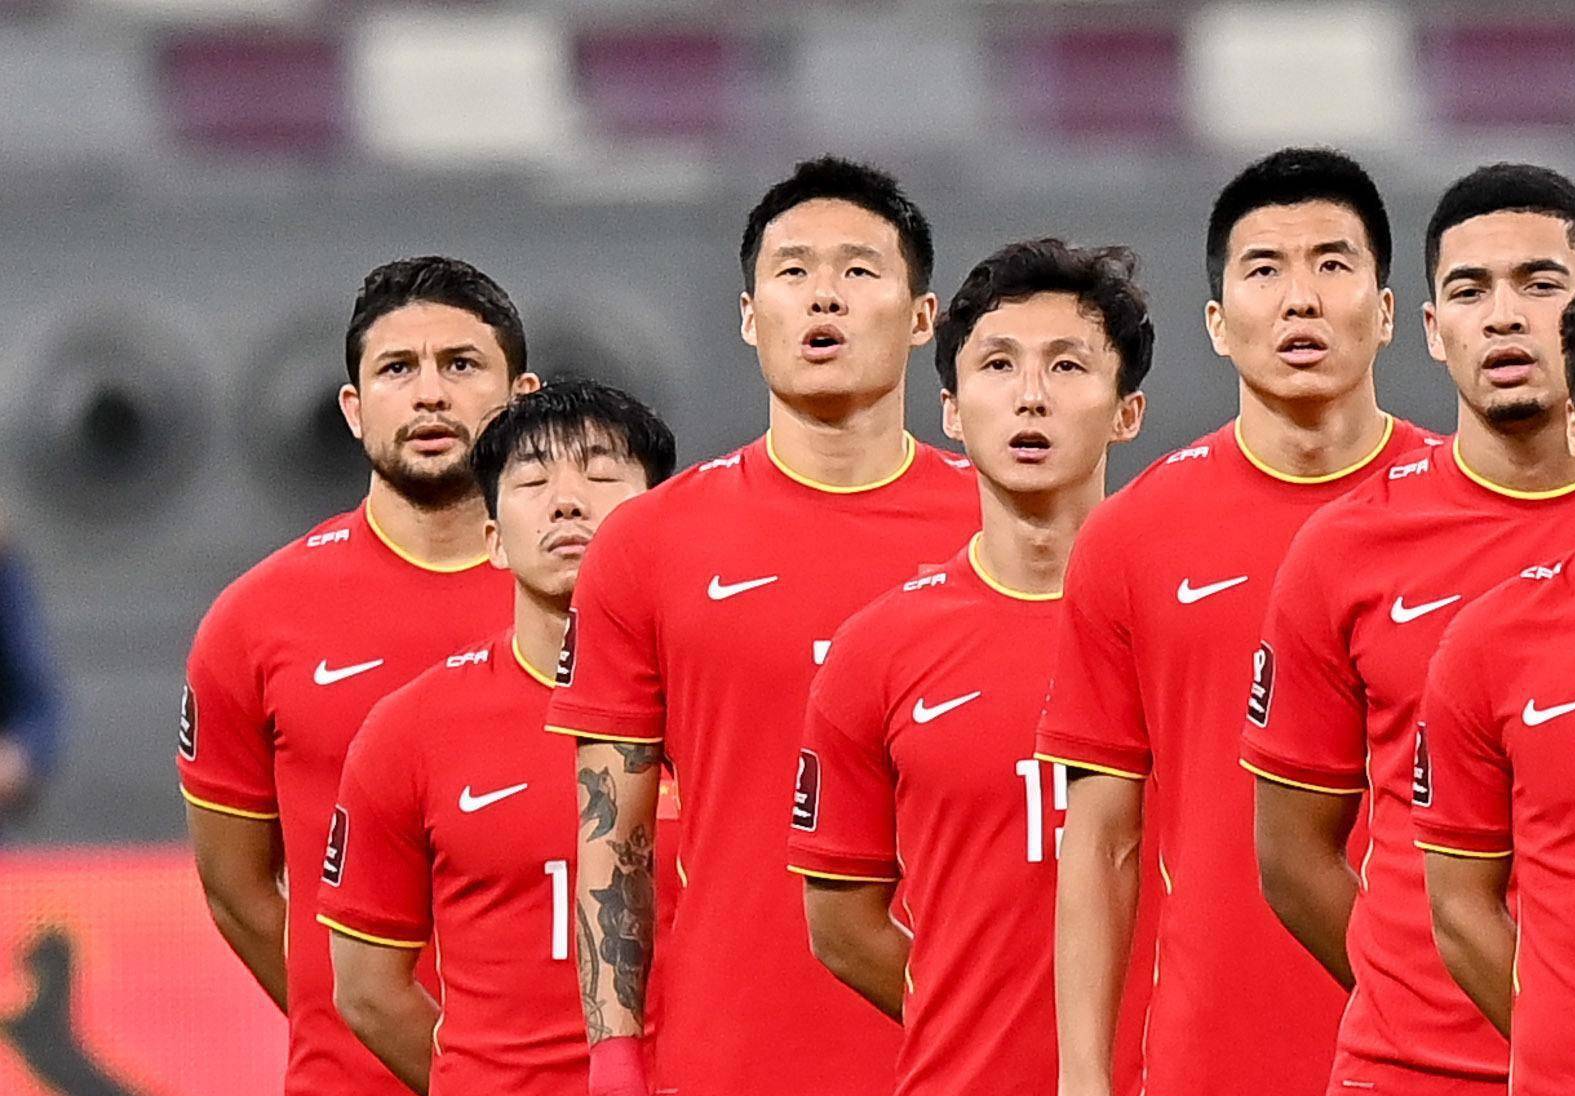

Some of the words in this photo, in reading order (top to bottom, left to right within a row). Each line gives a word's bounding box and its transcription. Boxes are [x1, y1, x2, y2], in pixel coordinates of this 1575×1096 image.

[1165, 446, 1209, 464] CFA
[1388, 458, 1429, 480] CFA
[306, 528, 350, 547] CFA
[903, 572, 946, 591] CFA
[446, 649, 489, 667] CFA
